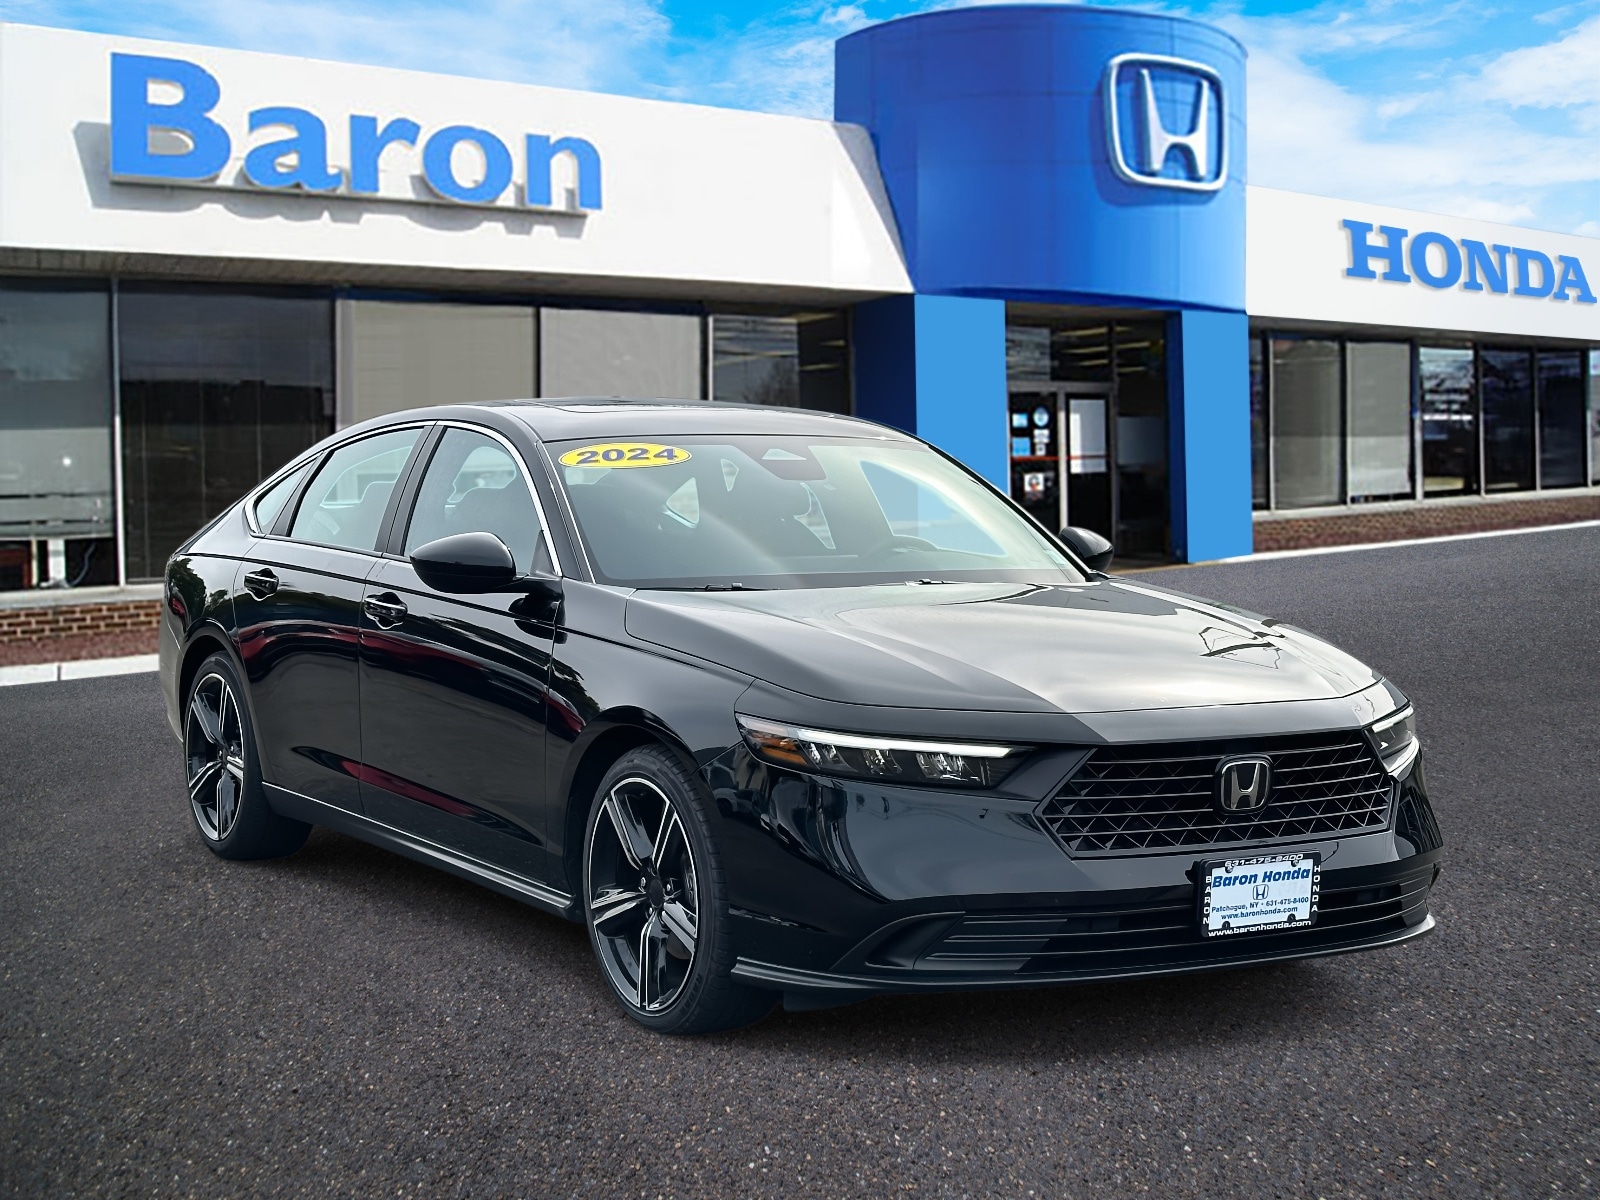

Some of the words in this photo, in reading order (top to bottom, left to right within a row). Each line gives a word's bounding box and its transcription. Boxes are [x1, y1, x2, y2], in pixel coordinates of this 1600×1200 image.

[110, 52, 603, 211] Baron
[1342, 218, 1598, 304] HONDA
[576, 447, 679, 465] 2024
[1203, 876, 1212, 924] BARON
[1212, 873, 1258, 888] Baron
[1262, 867, 1311, 883] Honda
[1311, 865, 1321, 912] HONDA
[1208, 920, 1312, 937] www.baronhonda.com
